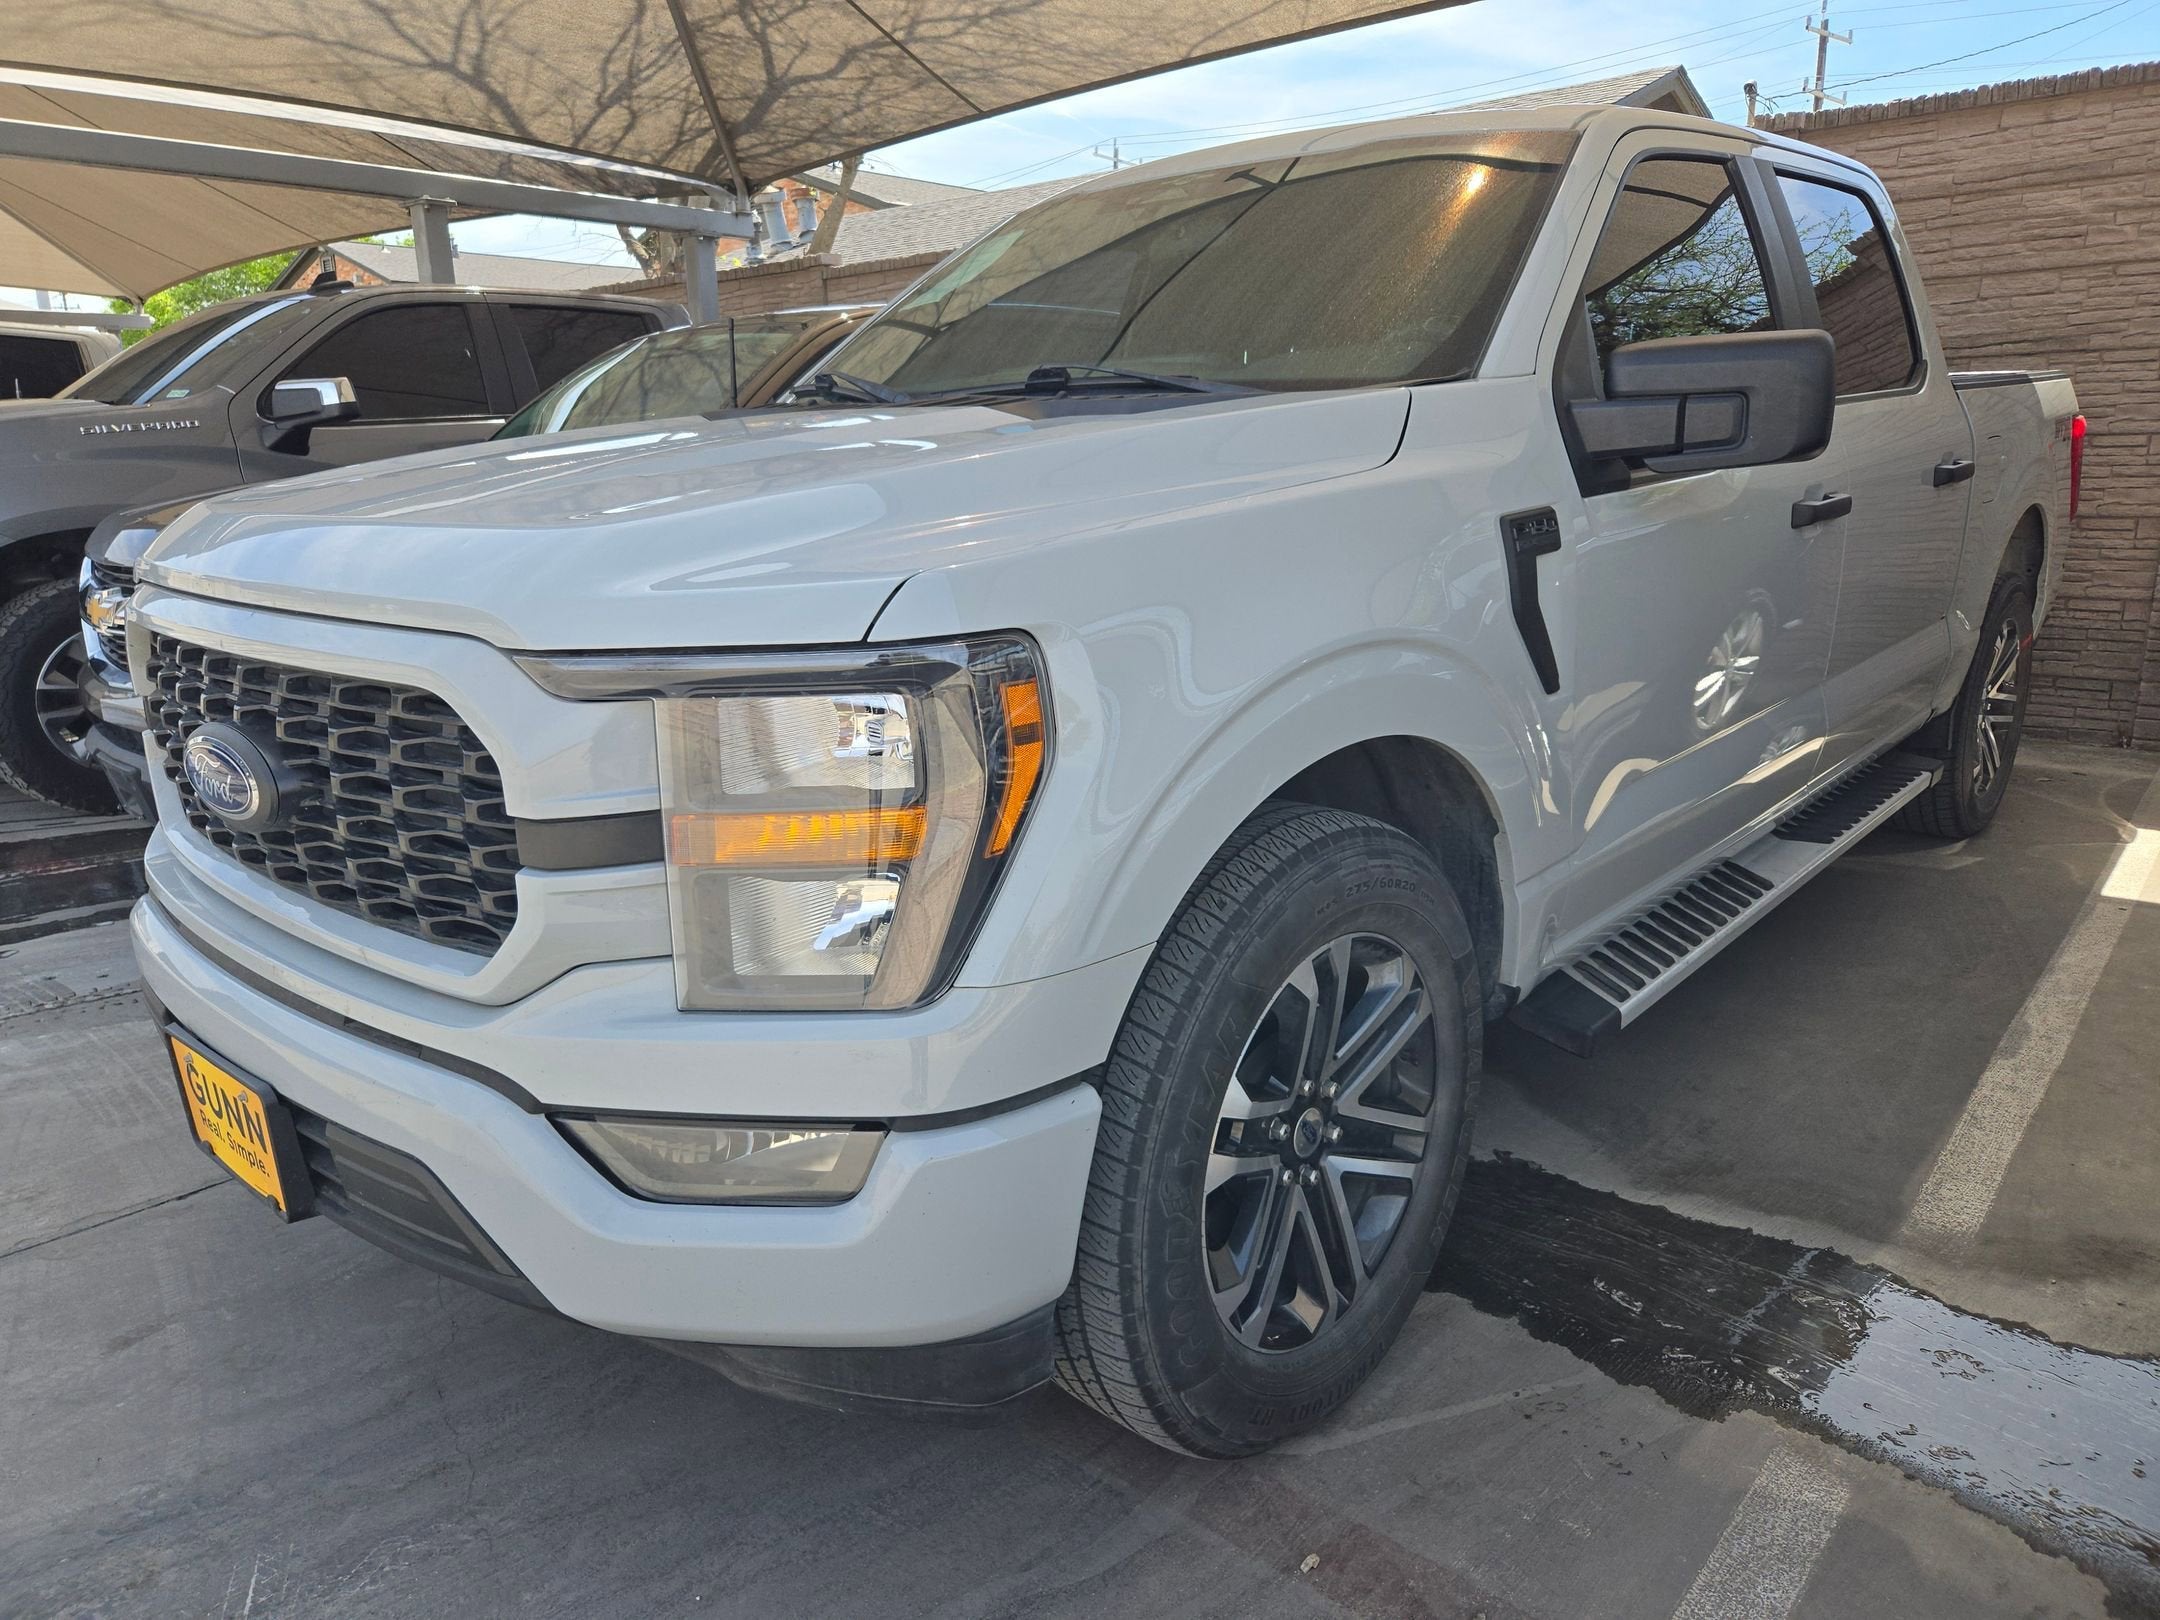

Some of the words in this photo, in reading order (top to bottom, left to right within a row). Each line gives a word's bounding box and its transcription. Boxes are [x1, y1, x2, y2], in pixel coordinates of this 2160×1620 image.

[80, 420, 199, 434] SILVERADO
[193, 753, 237, 804] Ford
[1345, 877, 1416, 898] 275/60R20
[186, 1063, 268, 1153] GUNN
[200, 1108, 226, 1143] Real.
[227, 1132, 270, 1177] Simple.
